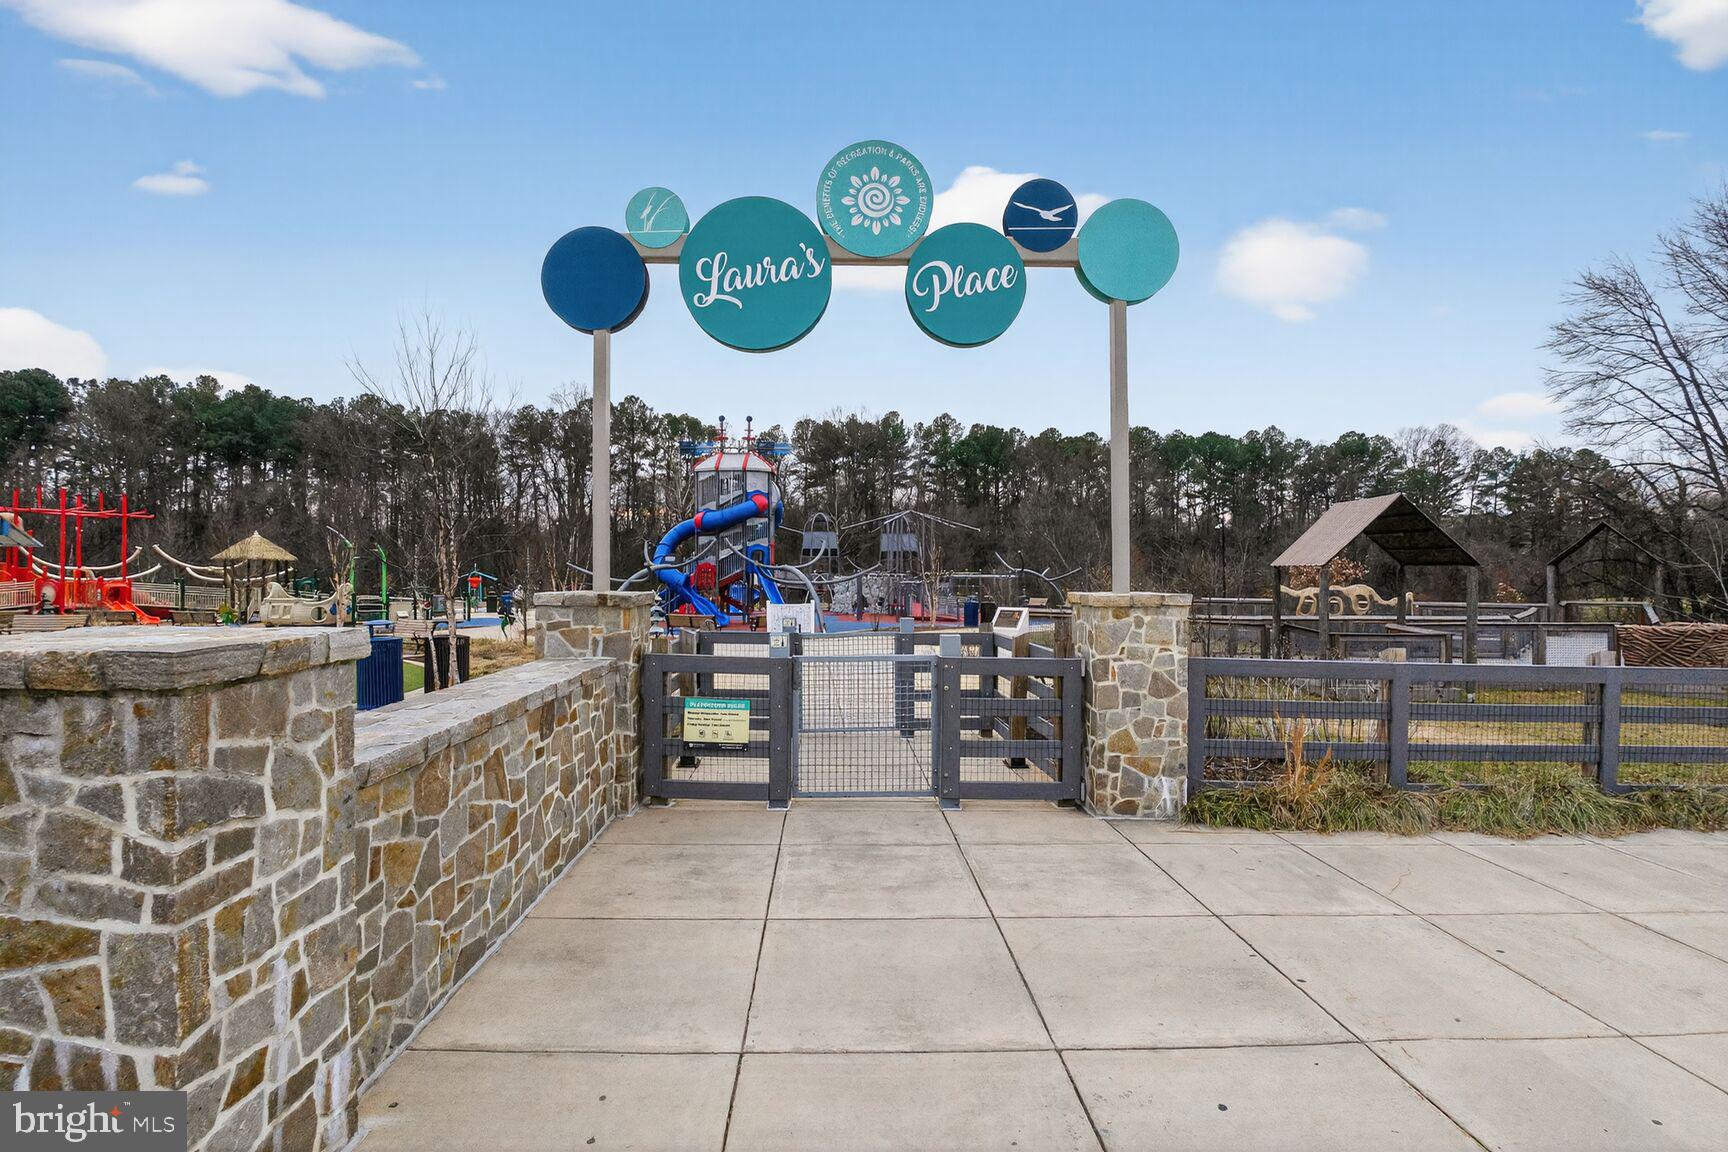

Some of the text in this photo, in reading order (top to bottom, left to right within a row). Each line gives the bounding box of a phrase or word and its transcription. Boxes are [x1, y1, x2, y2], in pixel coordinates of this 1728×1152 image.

[836, 146, 887, 168] RECREATION
[889, 149, 895, 158] &
[896, 152, 920, 177] PARKS
[828, 166, 838, 179] OF
[915, 177, 927, 193] ARE
[823, 180, 834, 219] BENEFITS
[693, 242, 826, 309] Laura's
[912, 260, 1018, 312] Place
